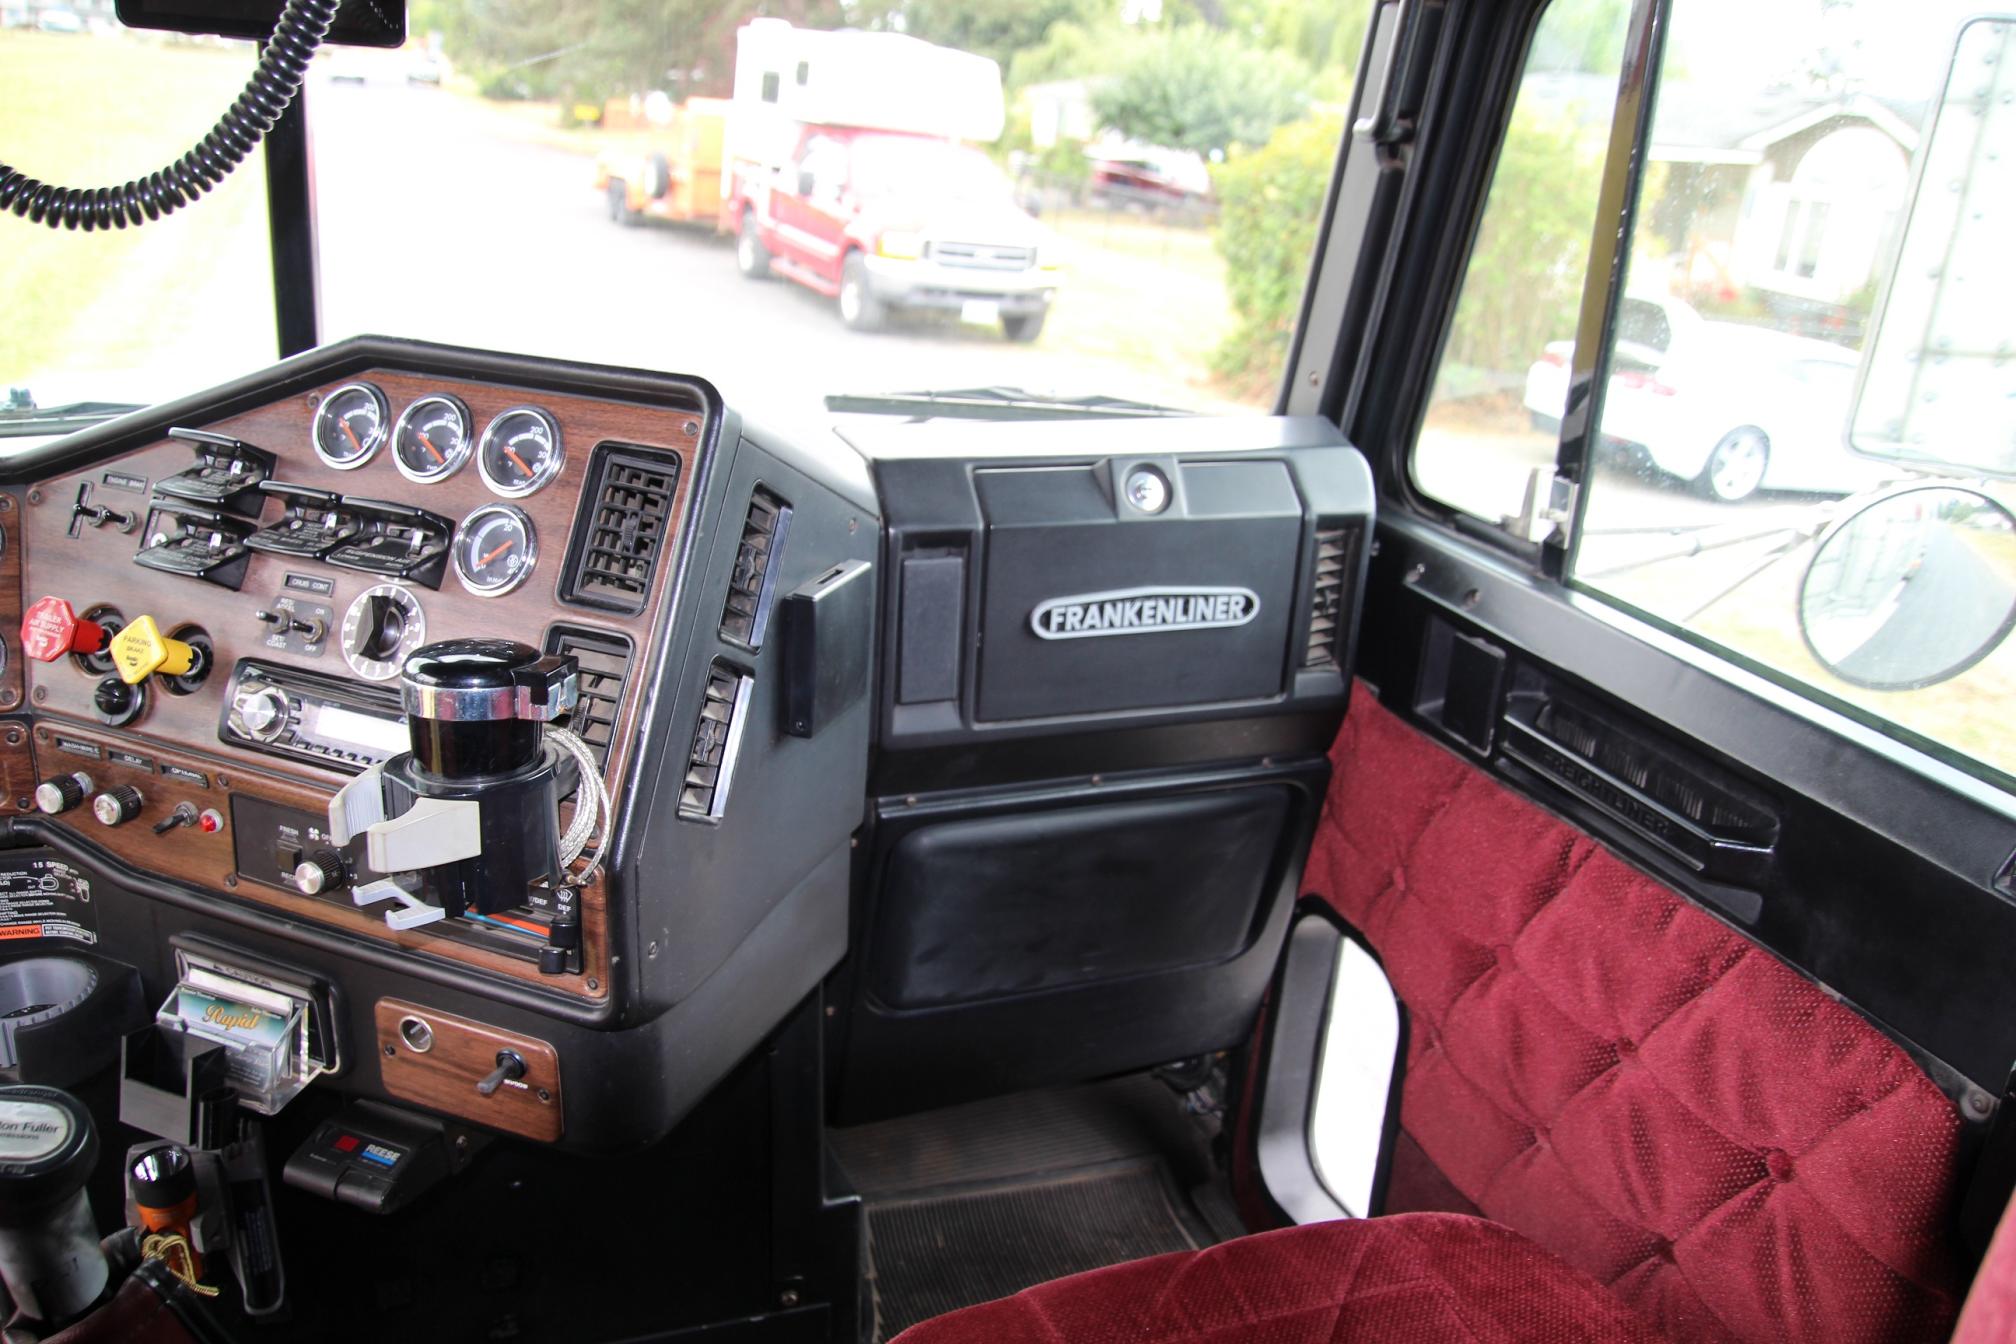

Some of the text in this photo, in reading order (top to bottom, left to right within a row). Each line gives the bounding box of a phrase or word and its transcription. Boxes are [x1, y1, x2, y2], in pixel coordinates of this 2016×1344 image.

[530, 426, 543, 434] 200
[1050, 595, 1246, 633] FRANKENLINER
[123, 635, 151, 647] PARKING
[33, 861, 69, 872] 15 SPEED
[558, 904, 571, 912] DEF
[0, 927, 40, 937] WARNING
[22, 1121, 60, 1134] Fuller
[366, 1143, 401, 1161] REESE
